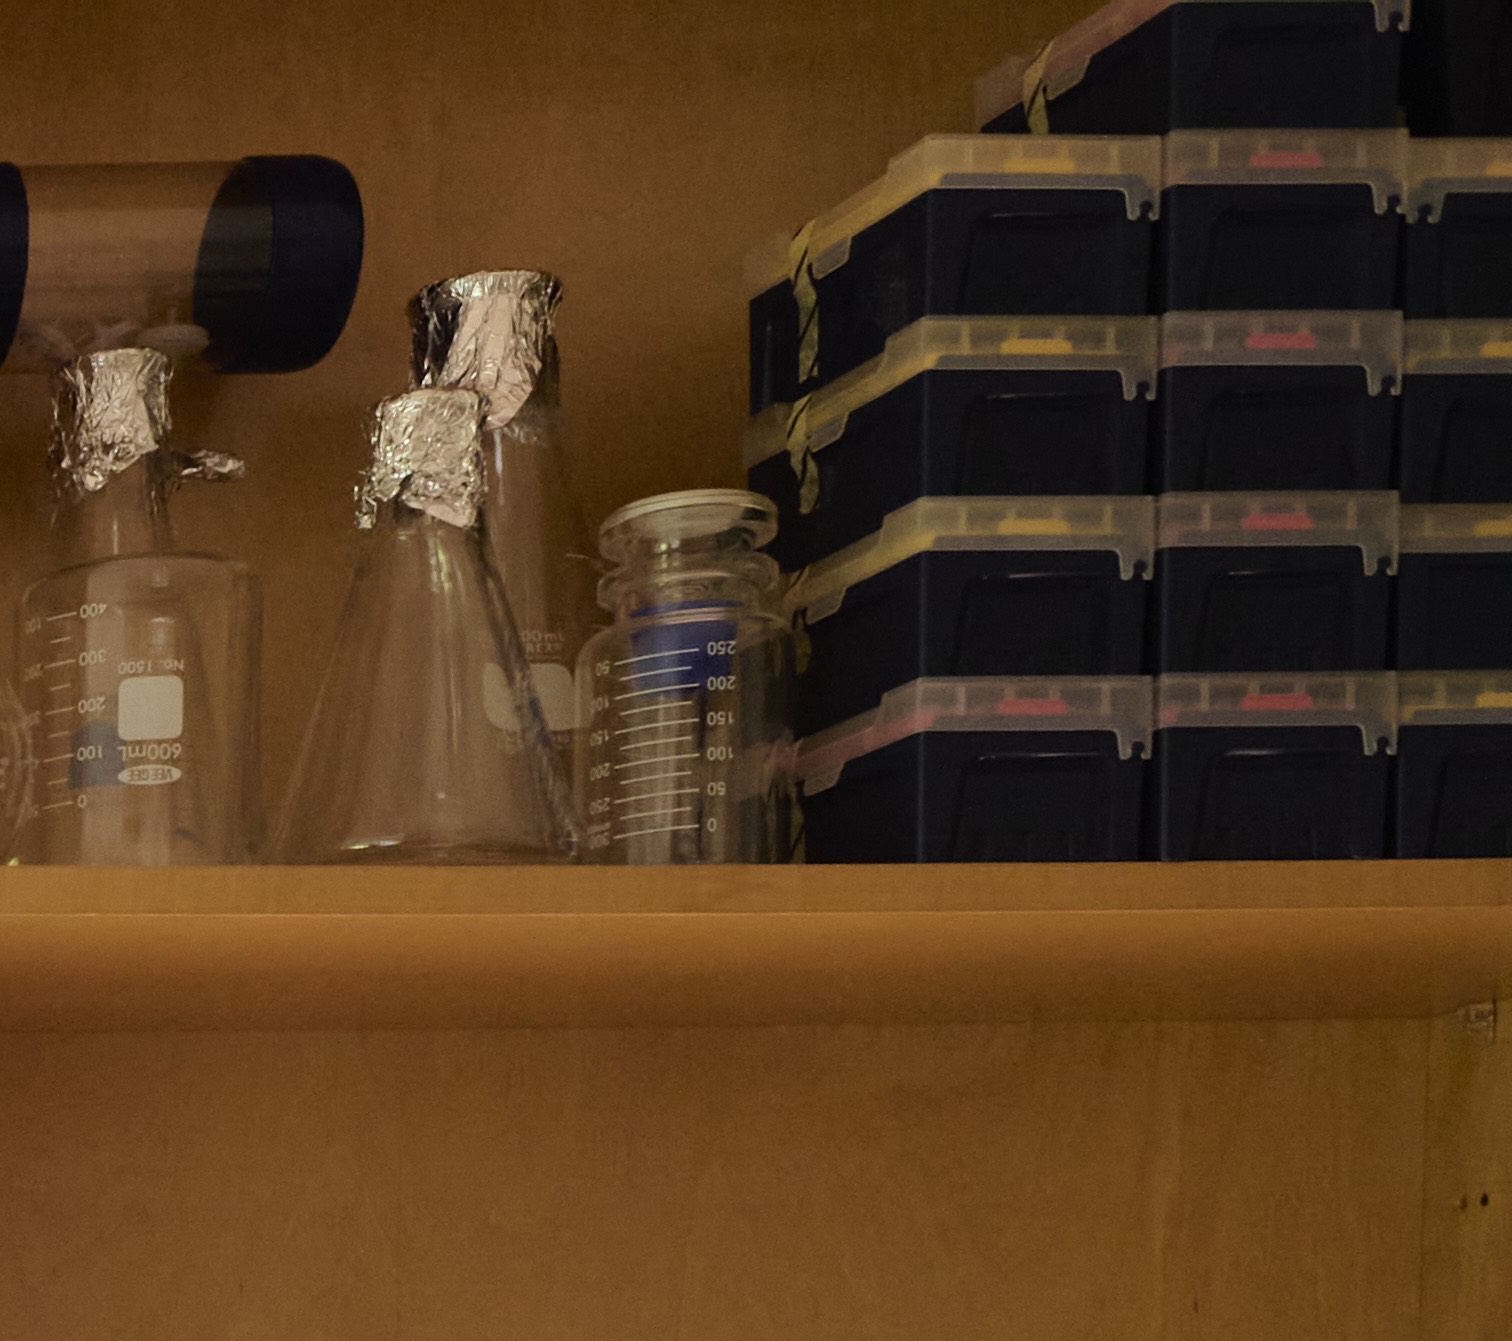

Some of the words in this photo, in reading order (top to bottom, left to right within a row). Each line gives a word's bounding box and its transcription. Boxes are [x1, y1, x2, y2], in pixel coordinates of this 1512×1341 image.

[79, 603, 107, 619] 400
[79, 650, 106, 665] 300
[77, 697, 105, 713] 200
[76, 746, 104, 761] 100
